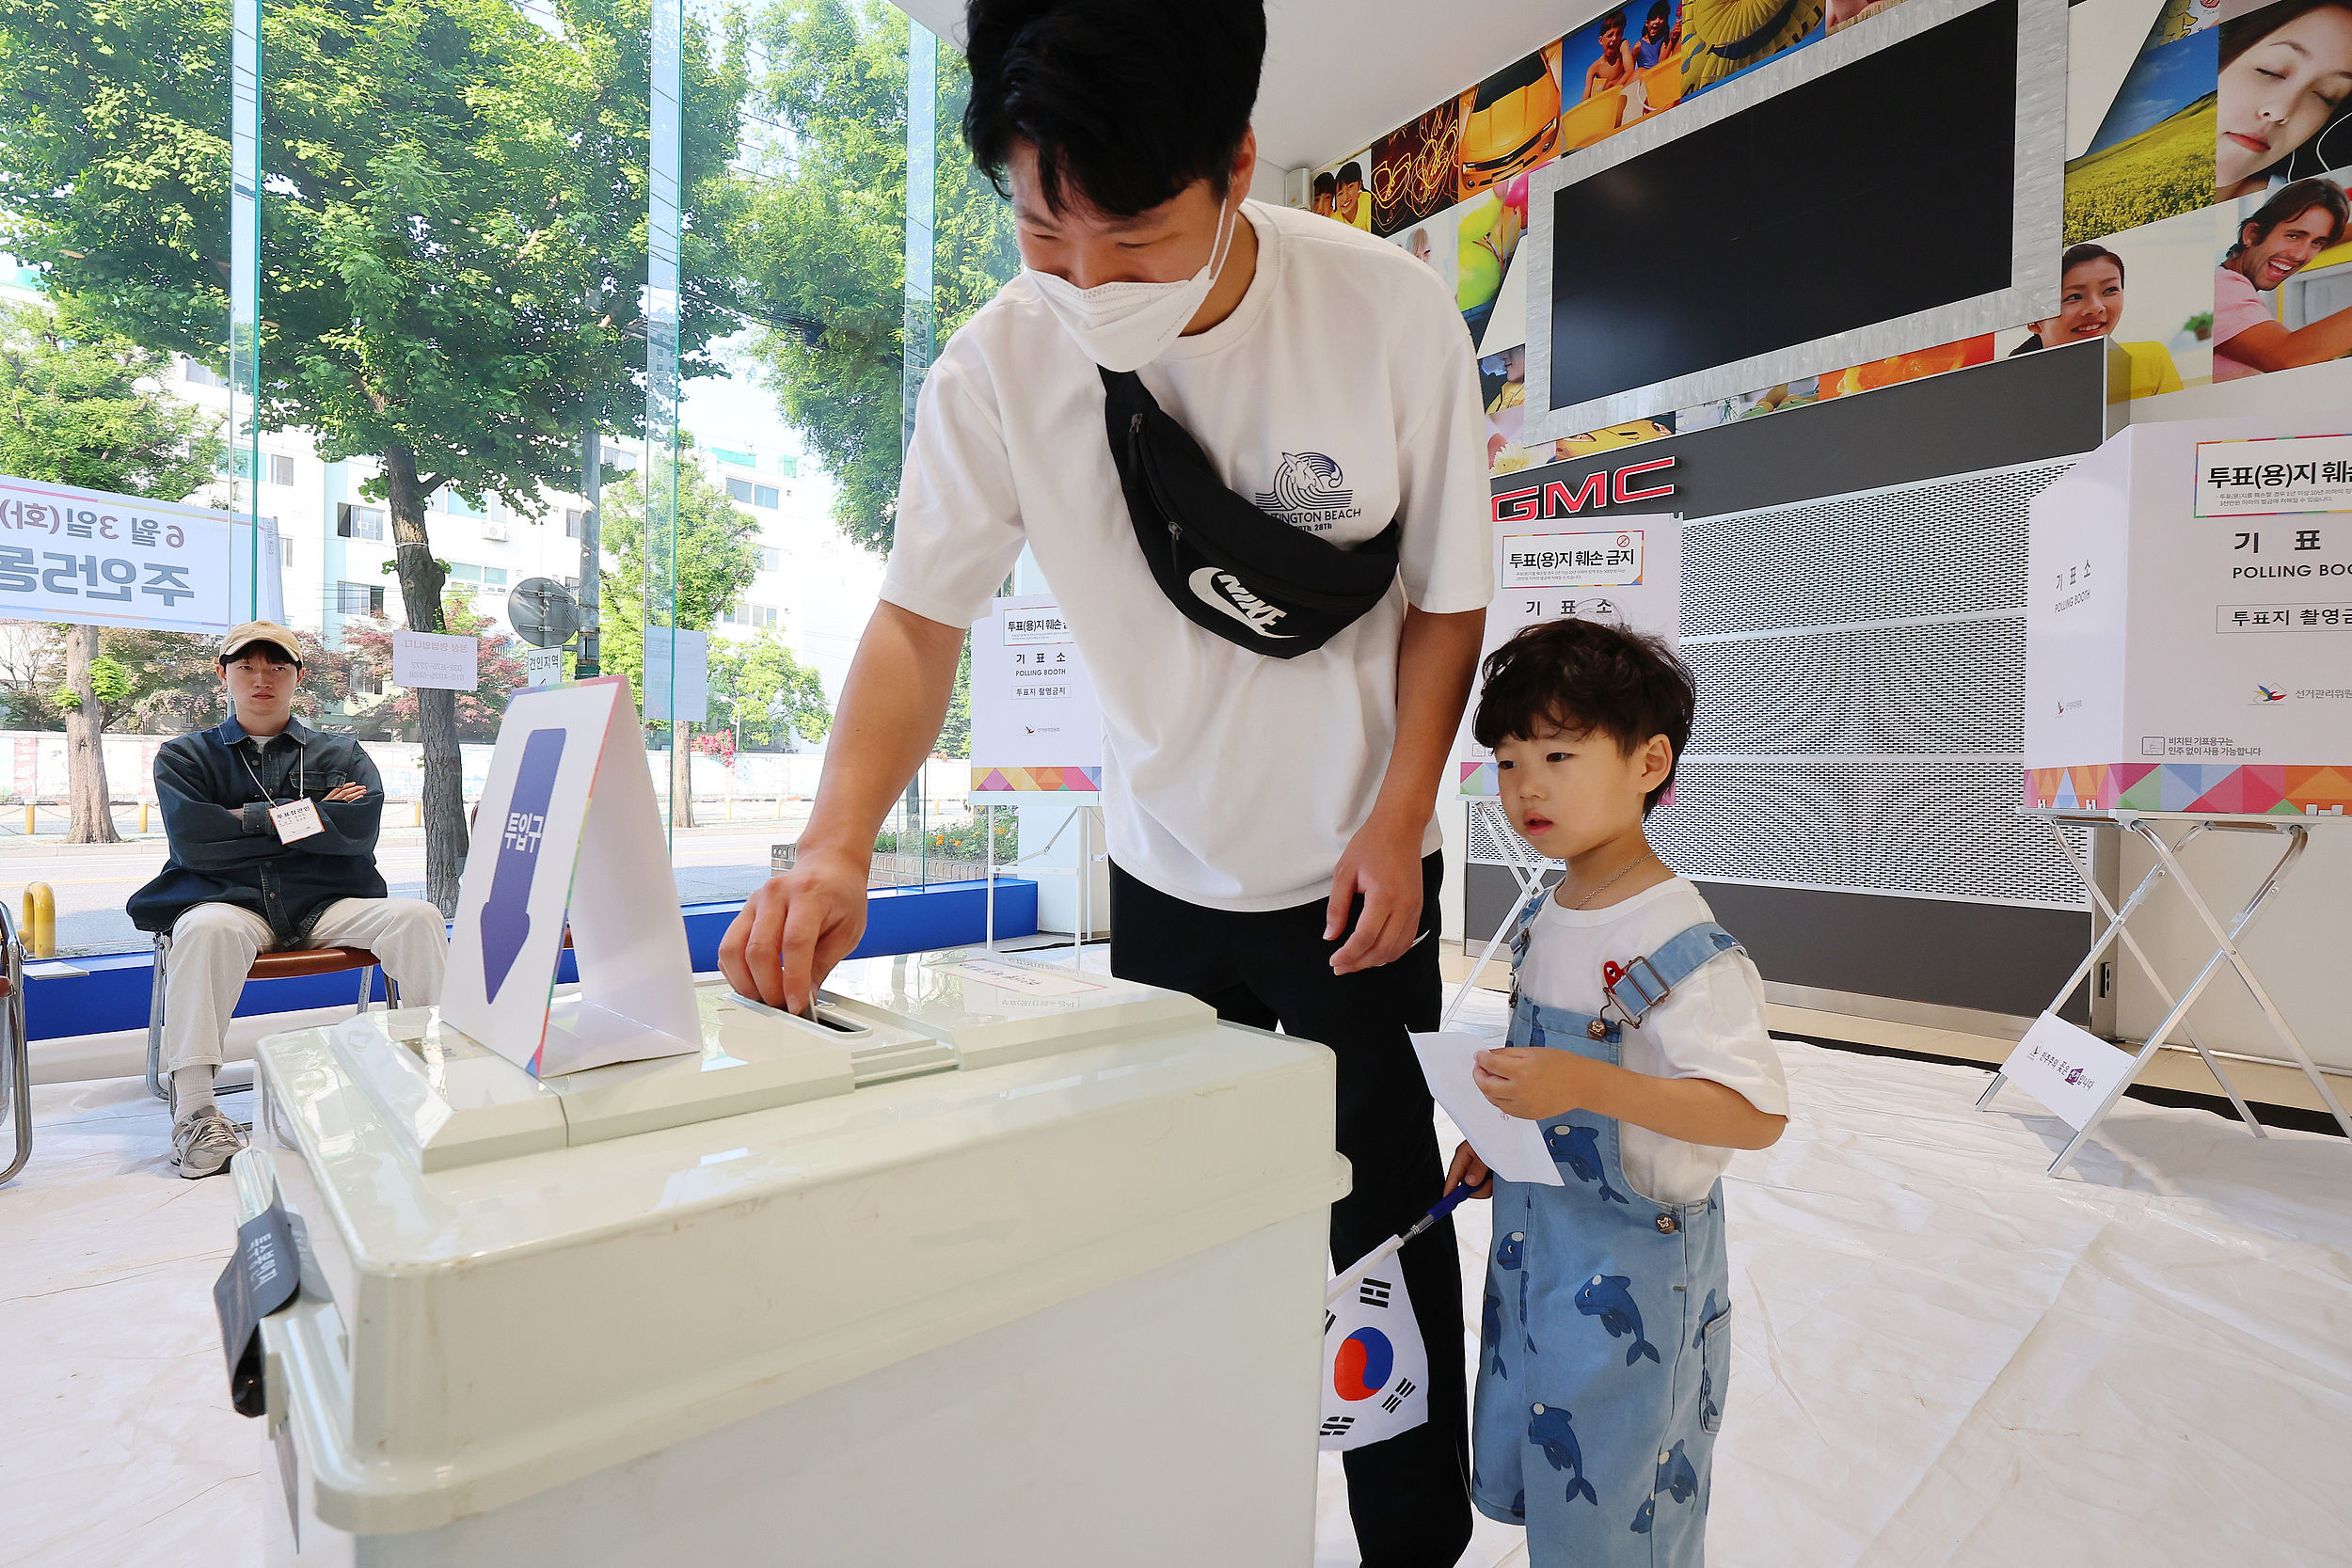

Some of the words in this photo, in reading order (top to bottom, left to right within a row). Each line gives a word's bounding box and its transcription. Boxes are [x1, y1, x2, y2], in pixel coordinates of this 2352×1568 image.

[2207, 462, 2316, 489] 투표(용)지
[2321, 460, 2352, 483] 훼
[1490, 456, 1676, 522] GMC
[1325, 508, 1361, 521] BEACH
[1509, 550, 1571, 569] 투표(용)지
[1575, 550, 1604, 566] 훼손
[1606, 548, 1634, 565] 금지
[2233, 564, 2312, 578] POLLING
[1217, 574, 1288, 632] NIKE
[2055, 596, 2074, 614] POLLING
[2074, 588, 2090, 605] BOOTH
[1008, 619, 1044, 632] 투표(용)지
[1045, 618, 1062, 630] 훼손
[2232, 610, 2290, 626] 투표지
[529, 654, 559, 671] 견인지역
[1015, 669, 1042, 677] POLLING
[1043, 668, 1066, 676] BOOTH
[1016, 687, 1036, 697] 투표지
[1038, 687, 1066, 696] 촬영금지
[2169, 736, 2192, 746] 비치된
[2194, 736, 2234, 747] 기표용구는
[2169, 747, 2185, 756] 인주
[2185, 747, 2201, 756] 없이
[2203, 747, 2219, 755] 사용
[2220, 747, 2262, 756] 가능합니다
[504, 812, 545, 853] 투입구
[2039, 1052, 2060, 1069] 민주주의
[2057, 1060, 2071, 1076] 꽃은
